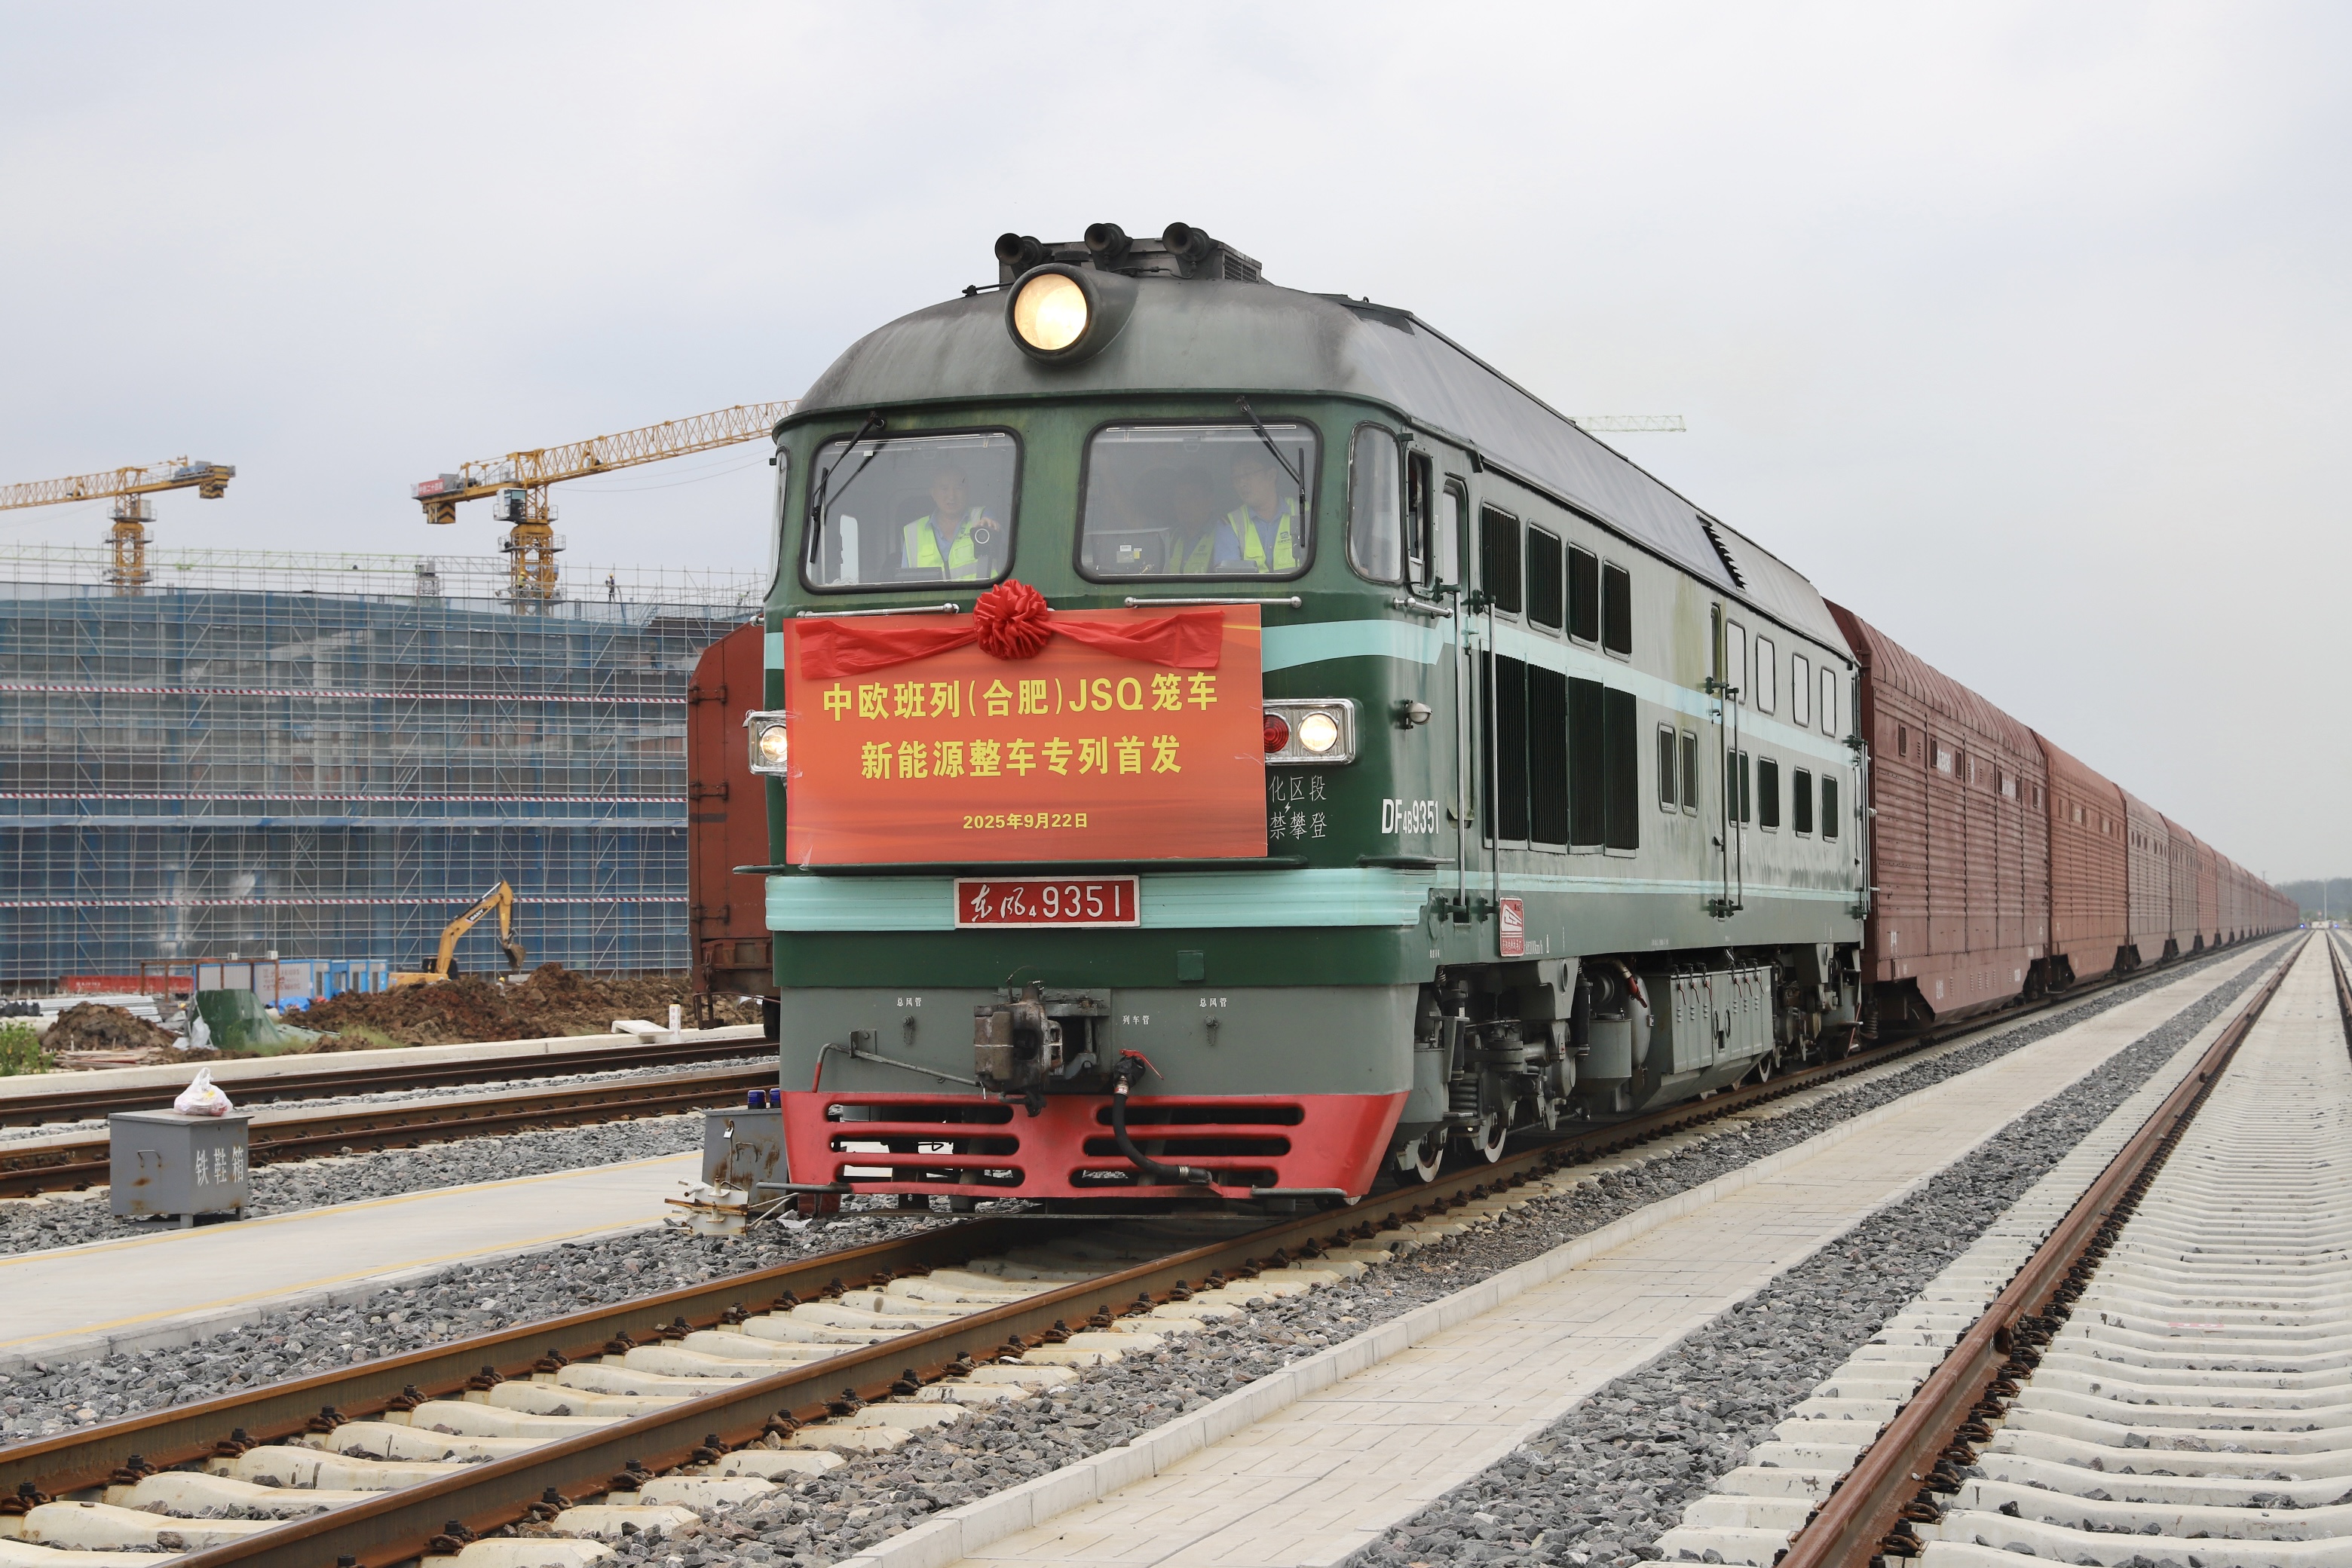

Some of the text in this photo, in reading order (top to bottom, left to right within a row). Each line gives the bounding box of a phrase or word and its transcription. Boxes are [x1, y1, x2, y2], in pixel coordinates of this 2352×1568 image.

[823, 672, 1218, 721] 中欧班列(合肥)JSQ笼车
[861, 734, 1183, 780] 新能源整车专列首发
[1269, 775, 1327, 803] 化区段
[963, 813, 1088, 830] 2025年9月22日
[1269, 811, 1328, 841] 禁攀登
[1381, 798, 1439, 835] DF4B9351
[896, 997, 922, 1007] 总风管
[1199, 997, 1227, 1008] 总风管
[1122, 1015, 1150, 1025] 列车管
[195, 1146, 244, 1187] 铁鞋箱
